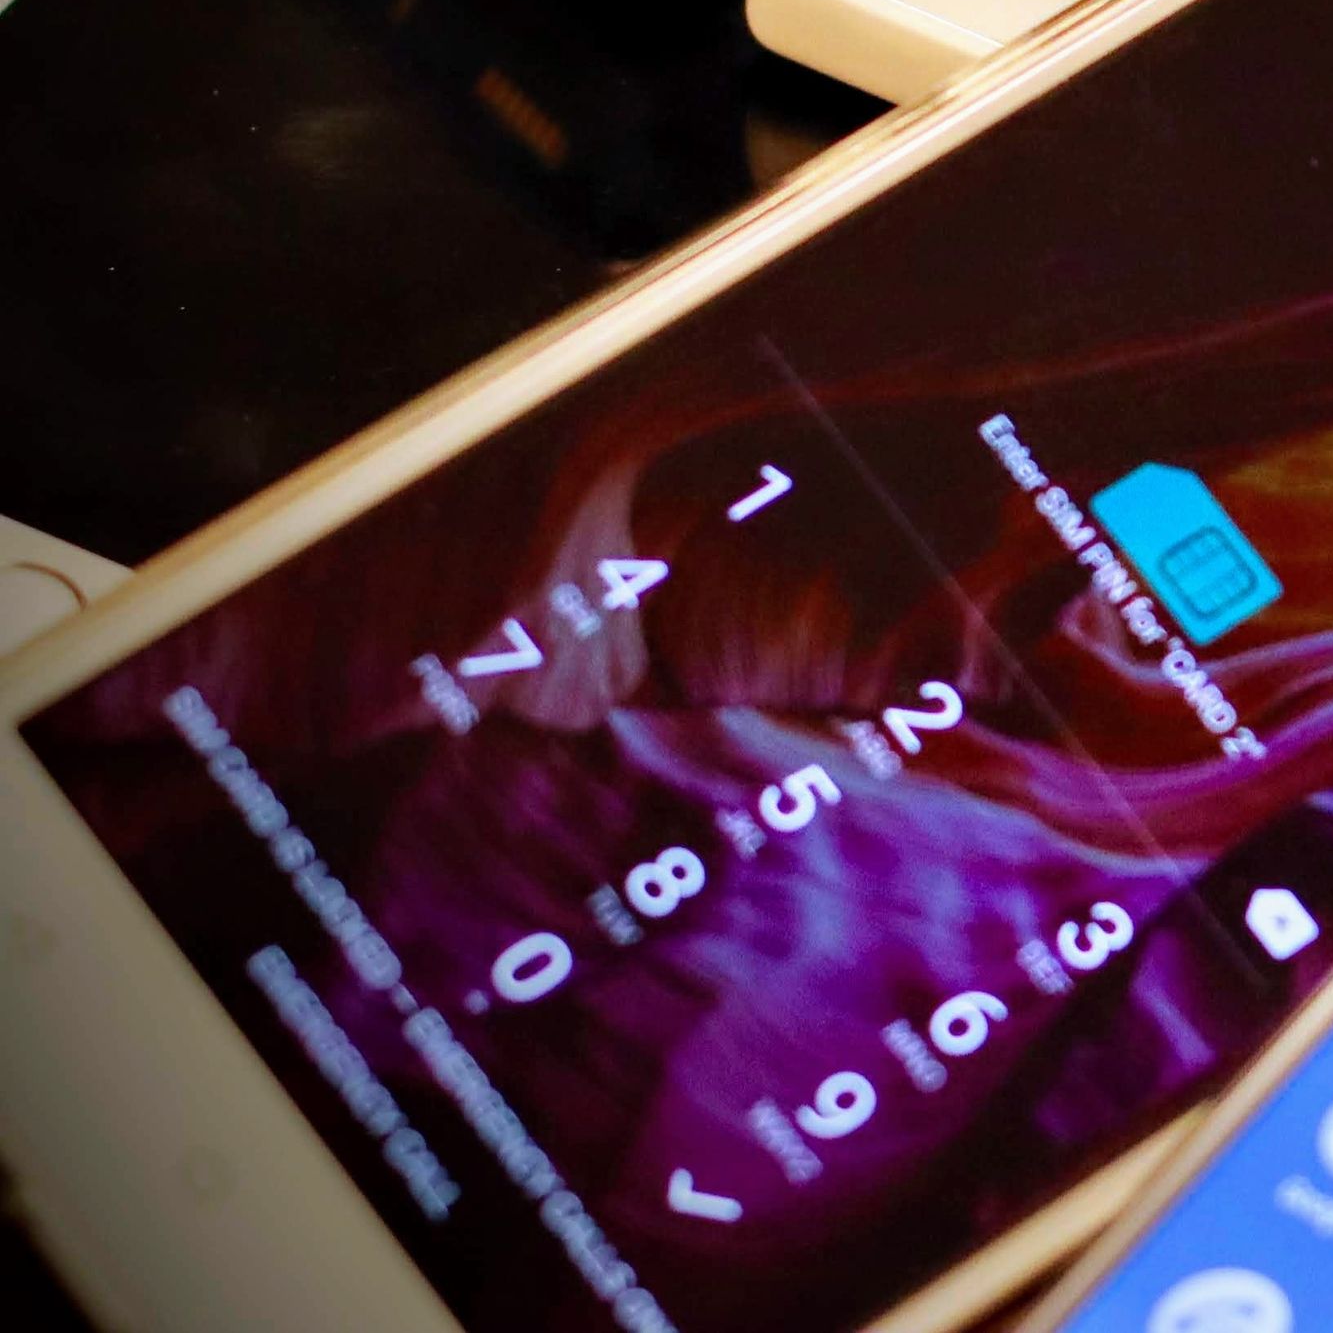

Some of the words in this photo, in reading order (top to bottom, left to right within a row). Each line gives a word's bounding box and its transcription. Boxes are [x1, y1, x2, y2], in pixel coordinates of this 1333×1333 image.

[727, 464, 794, 522] 1
[979, 414, 1049, 492] Enter
[1034, 486, 1097, 551] SIM
[1077, 541, 1138, 604] PIN
[1120, 596, 1169, 646] for
[597, 558, 670, 610] 4
[456, 617, 544, 678] 7
[881, 680, 963, 755] 2
[758, 763, 842, 833] 5
[625, 846, 706, 918] 8
[490, 931, 574, 1003] 0
[1056, 901, 1134, 971] 3
[929, 990, 1009, 1057] 6
[794, 1071, 878, 1140] 9
